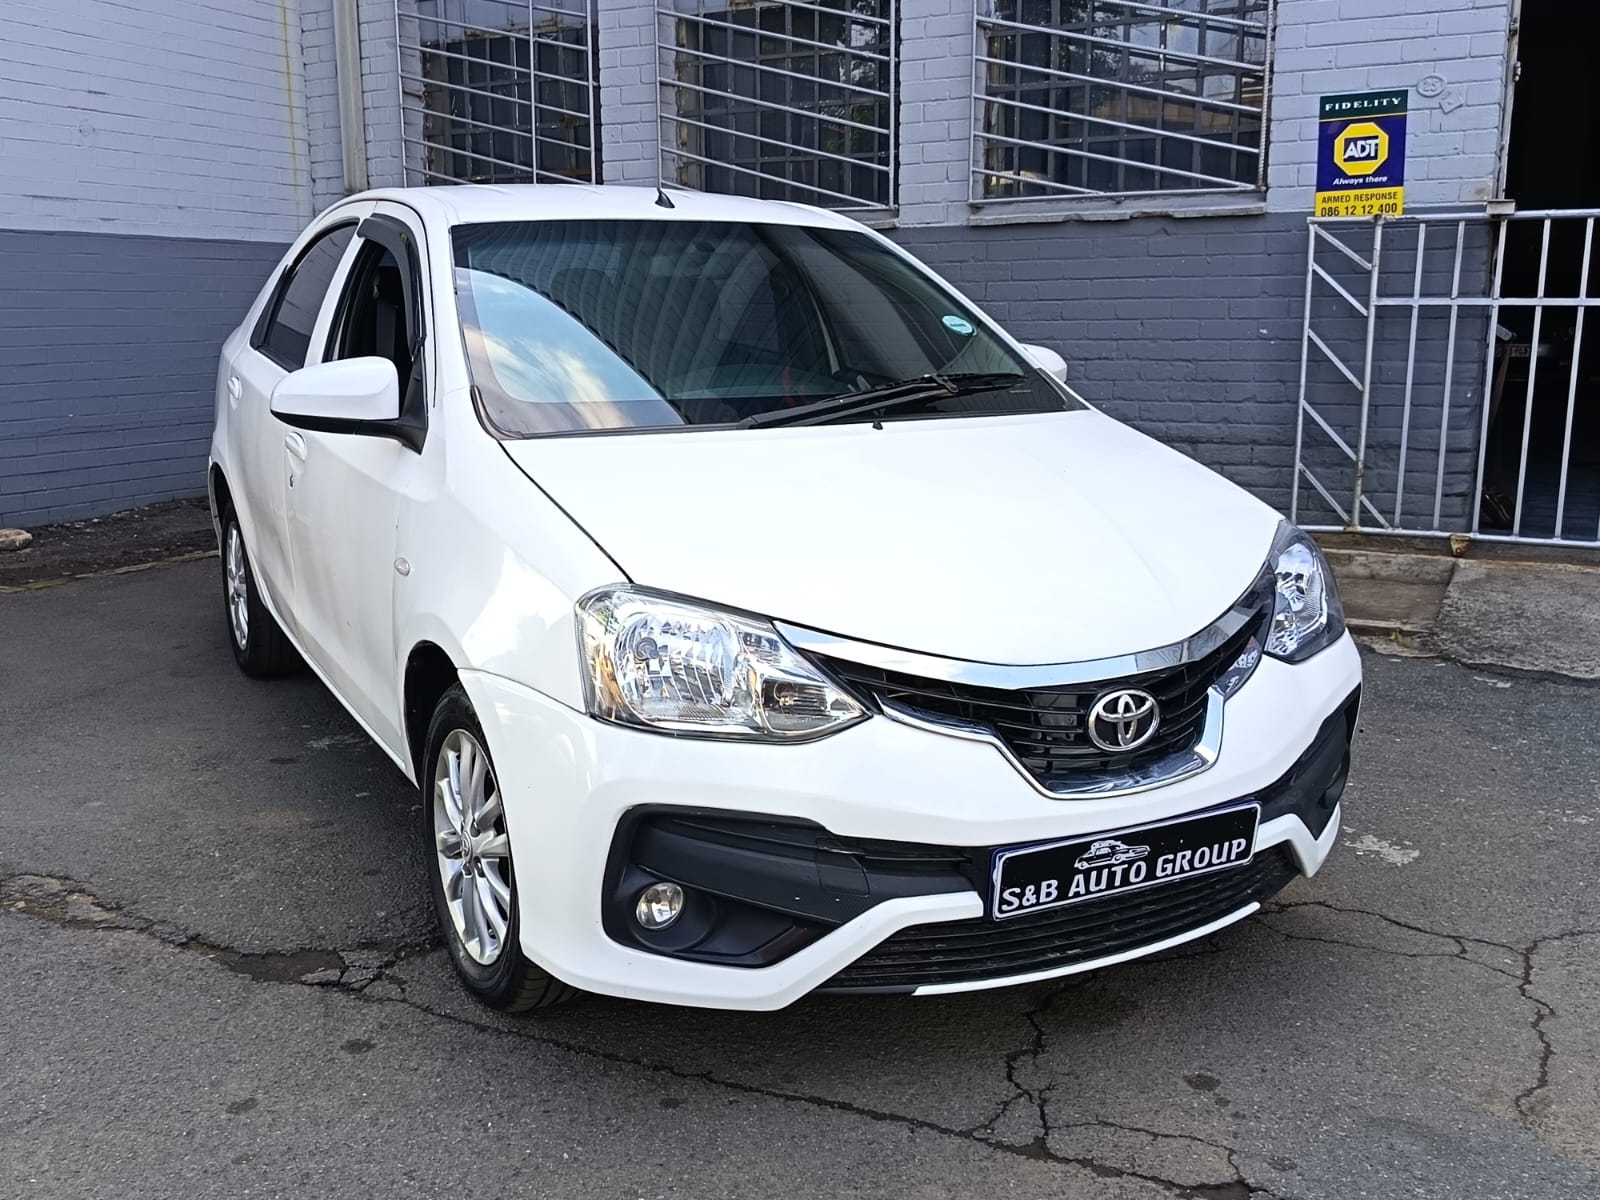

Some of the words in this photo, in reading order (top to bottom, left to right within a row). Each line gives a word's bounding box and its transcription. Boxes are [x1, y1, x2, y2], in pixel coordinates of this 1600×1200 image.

[1325, 98, 1402, 111] FIDELITY
[1344, 139, 1378, 159] ADT
[1333, 178, 1363, 186] Always
[1322, 195, 1351, 204] ARMED
[1354, 192, 1398, 202] RESPONSE
[1321, 206, 1340, 217] 086
[1344, 205, 1357, 216] 12
[1361, 204, 1374, 215] 12
[1378, 202, 1398, 214] 400
[1001, 879, 1058, 912] S&B
[1068, 861, 1147, 897] AUTO
[1155, 838, 1247, 878] GROUP
